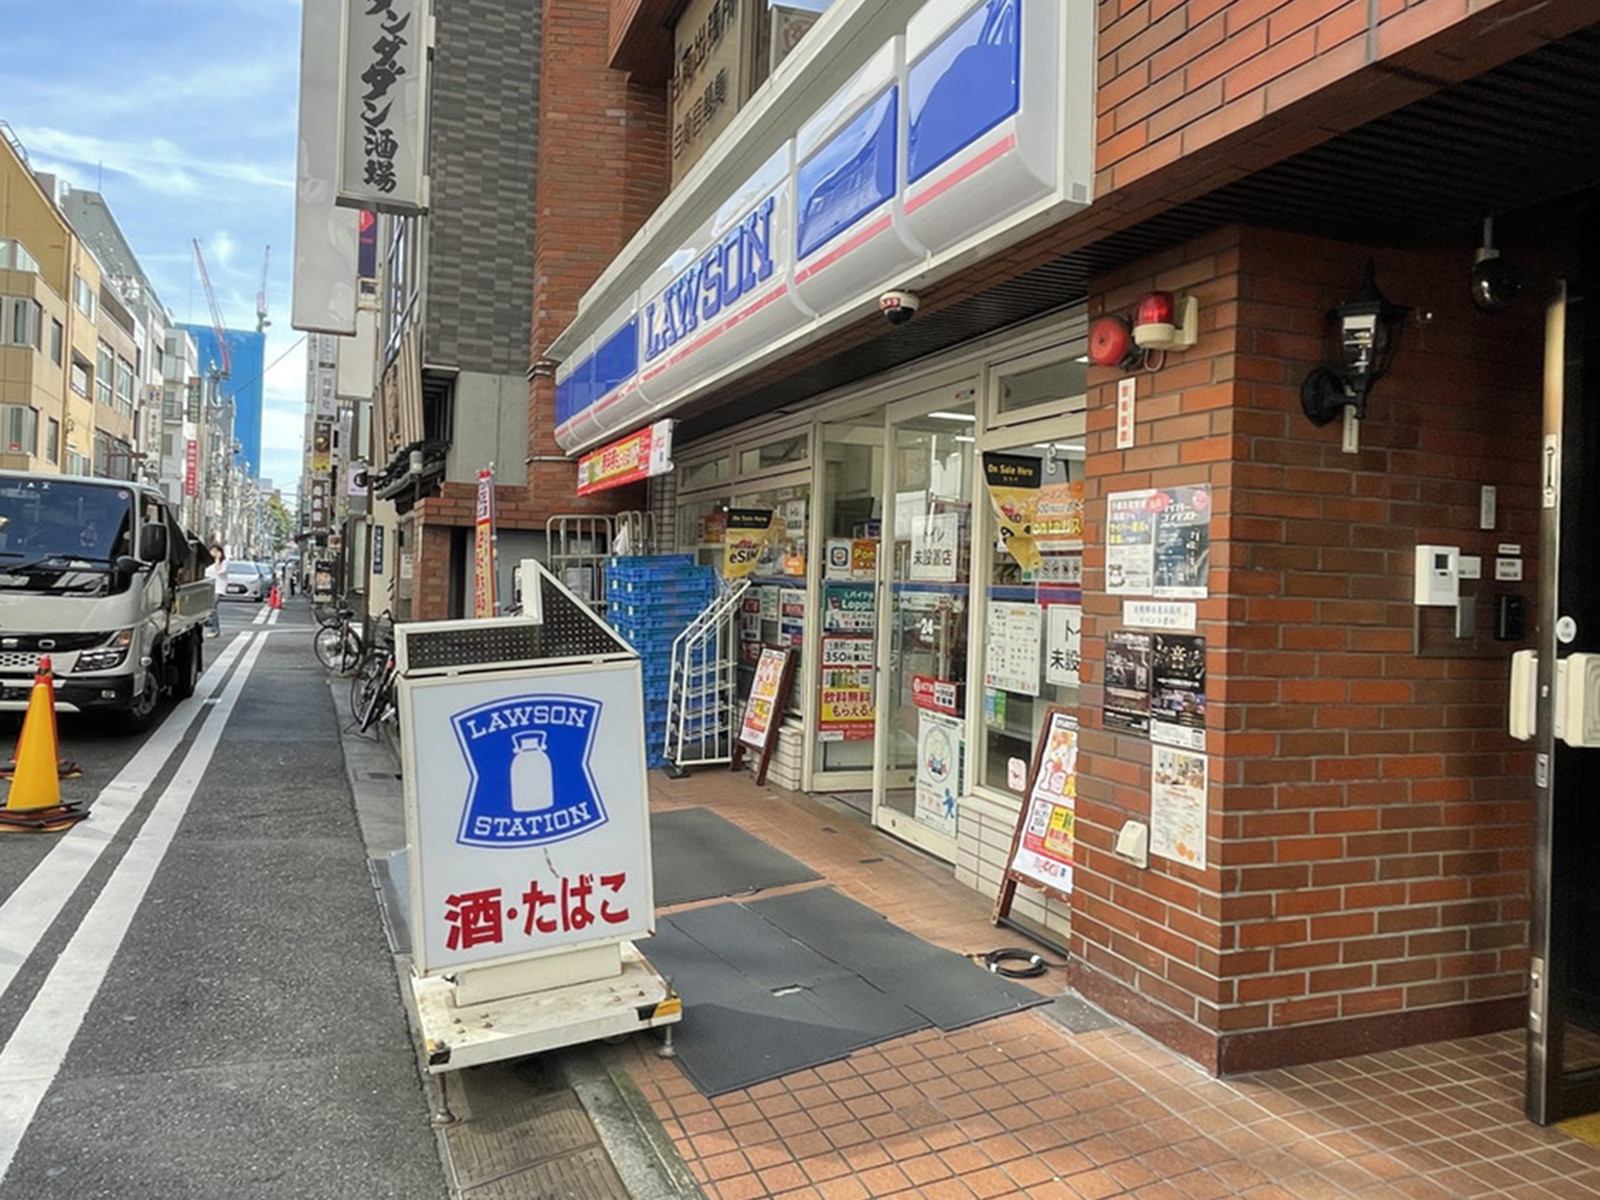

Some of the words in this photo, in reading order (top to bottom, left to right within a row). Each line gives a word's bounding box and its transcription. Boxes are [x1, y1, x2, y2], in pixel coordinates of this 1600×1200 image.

[645, 196, 775, 362] LAWSON
[466, 705, 588, 739] LAWSON
[473, 801, 591, 837] STATION
[443, 872, 629, 951] 酒・たばこ
